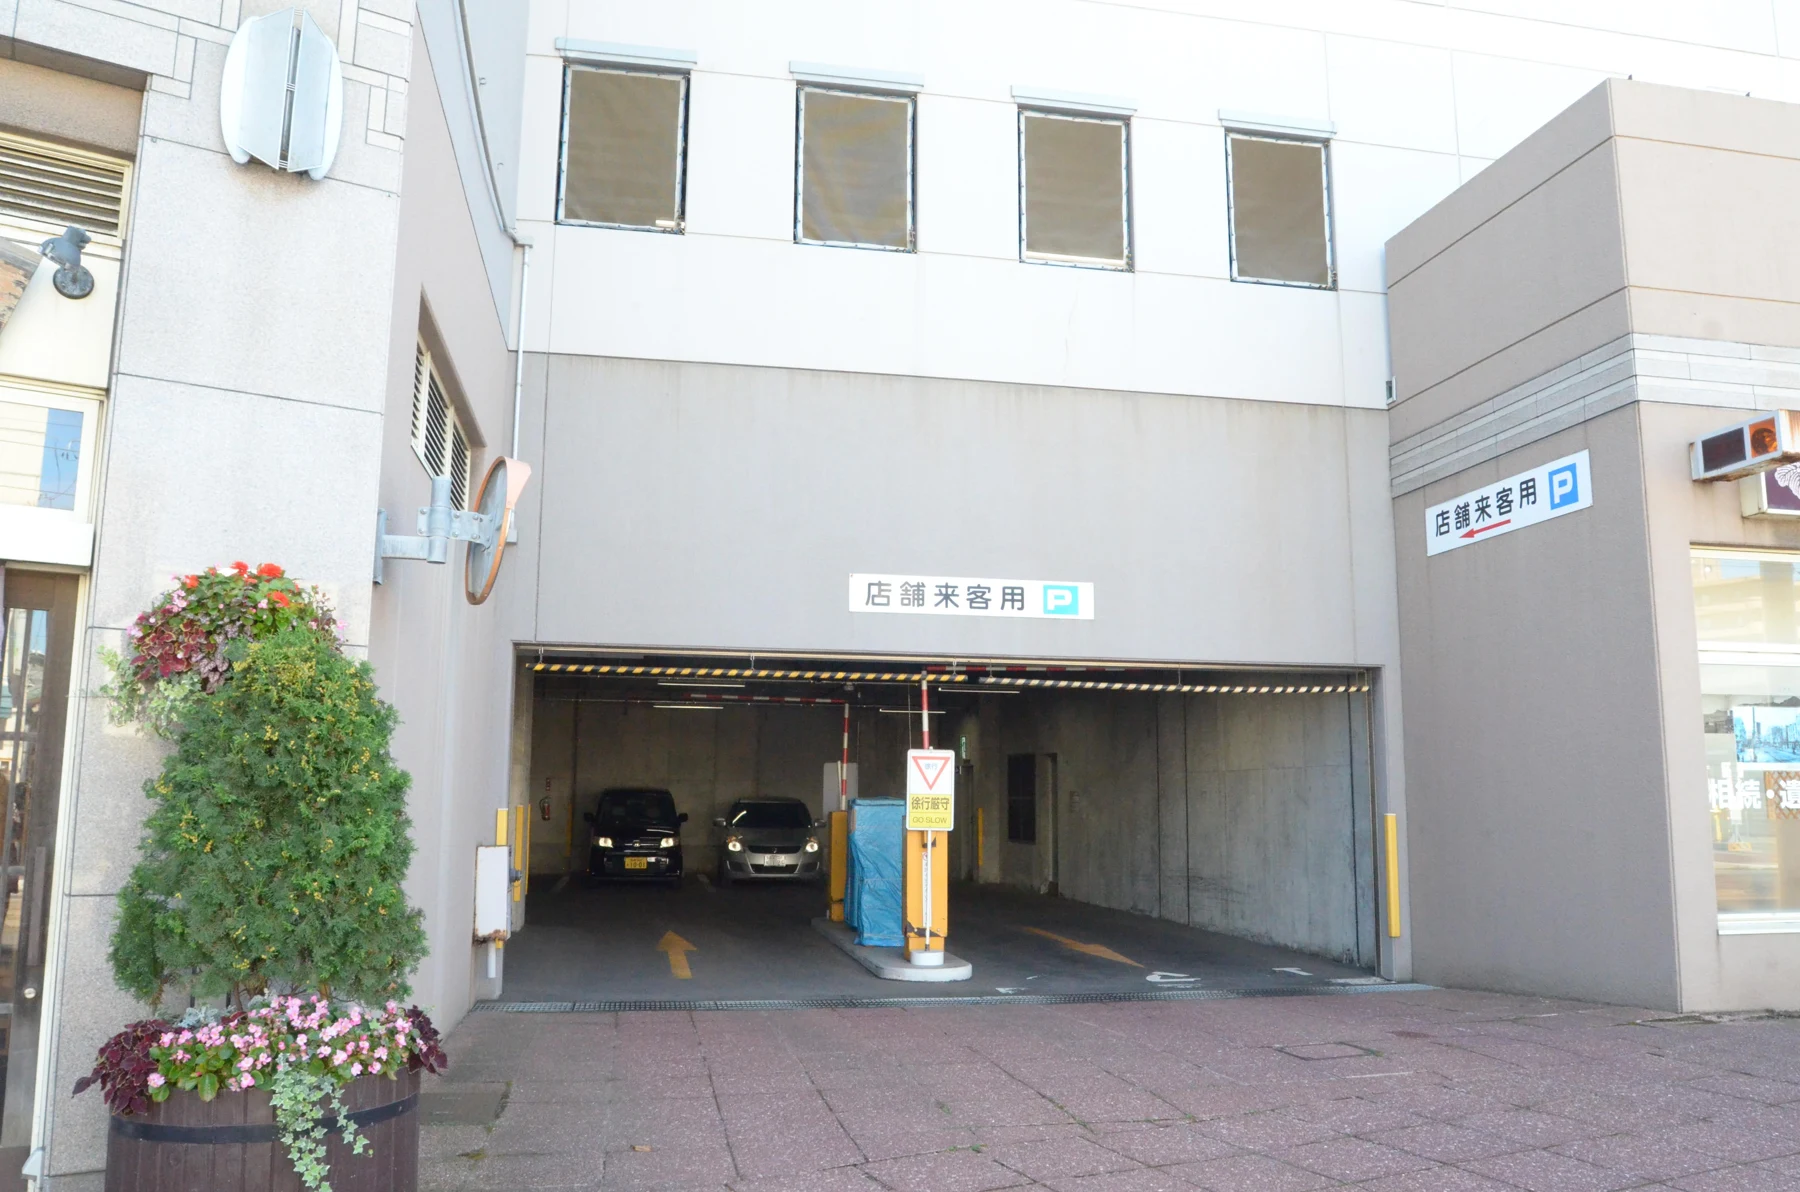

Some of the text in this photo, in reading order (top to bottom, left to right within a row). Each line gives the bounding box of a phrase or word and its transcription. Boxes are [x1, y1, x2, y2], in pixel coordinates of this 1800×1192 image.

[1435, 470, 1574, 537] 店舗来客用 P
[865, 580, 1072, 611] 店舗来客用 P
[911, 796, 950, 810] 徐行厳守
[912, 816, 948, 824] GO SLOW
